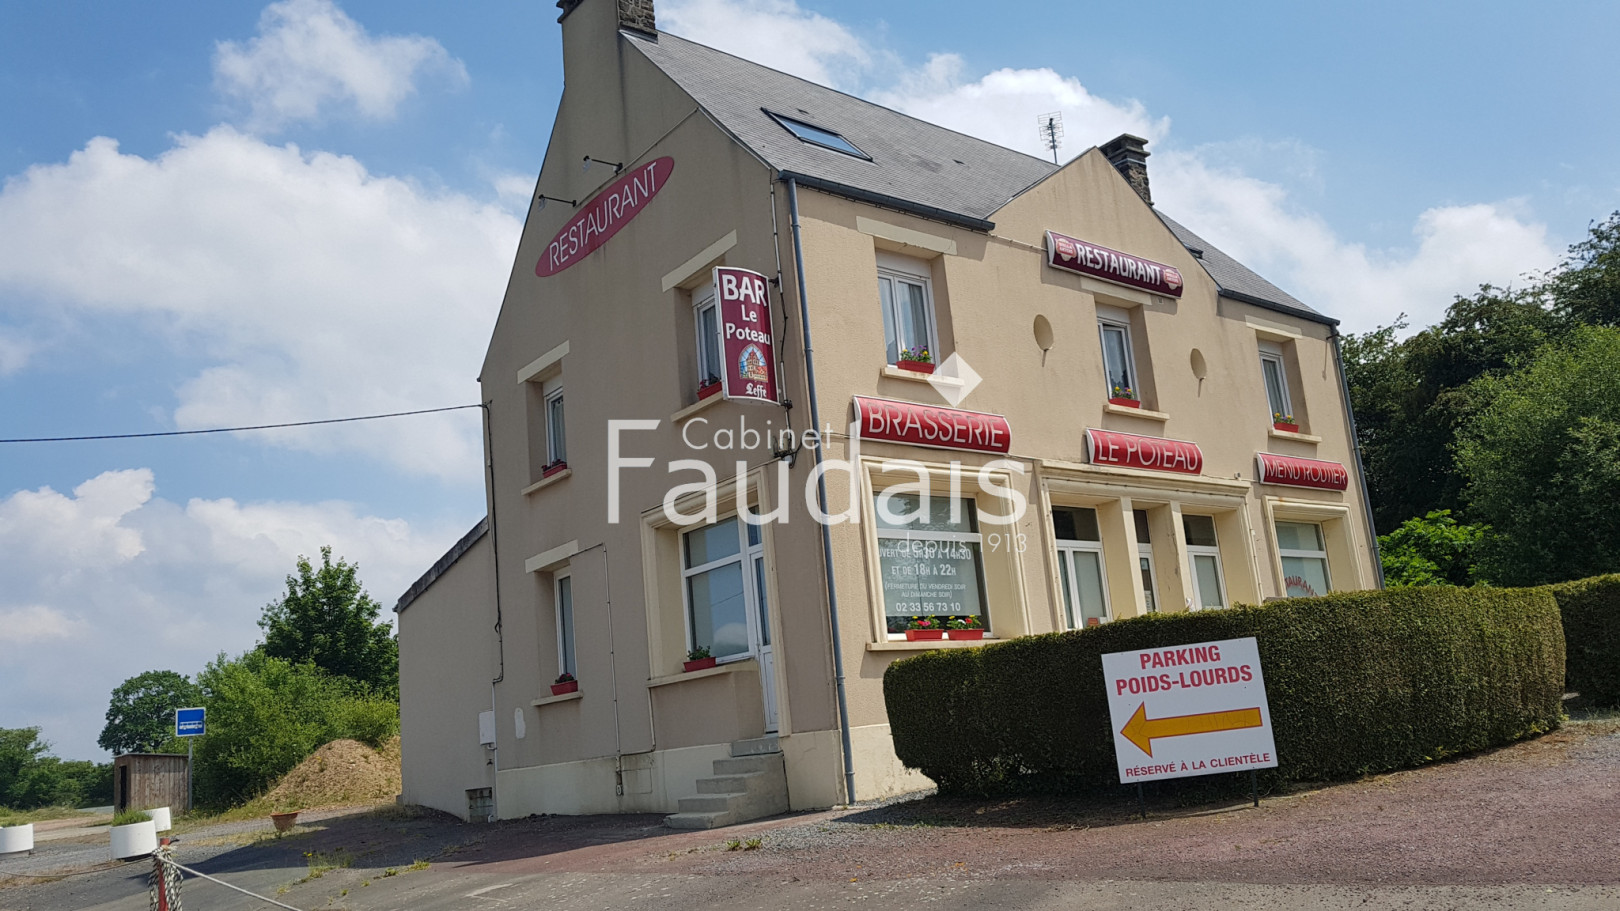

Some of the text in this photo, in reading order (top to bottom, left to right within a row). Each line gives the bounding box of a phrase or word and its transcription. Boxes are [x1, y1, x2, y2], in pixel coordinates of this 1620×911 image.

[549, 162, 657, 271] RESTAURANT
[1075, 243, 1160, 286] RESTAURANT
[721, 274, 767, 307] BAR
[741, 304, 757, 323] Le
[725, 323, 771, 346] Poteau
[745, 382, 767, 398] Leffe
[867, 403, 1004, 448] BRASSERIE
[1095, 433, 1198, 471] LE POTEAU
[1264, 458, 1346, 485] MENU ROUTIER
[891, 566, 900, 575] ET
[902, 566, 911, 575] DE
[896, 602, 961, 612] 02 33 56 73 10
[1139, 645, 1221, 670] PARKING
[1115, 665, 1253, 696] POIDS-LOURDS
[1125, 753, 1271, 777] RÉSERVÉ À LA CLIENTÈLE
